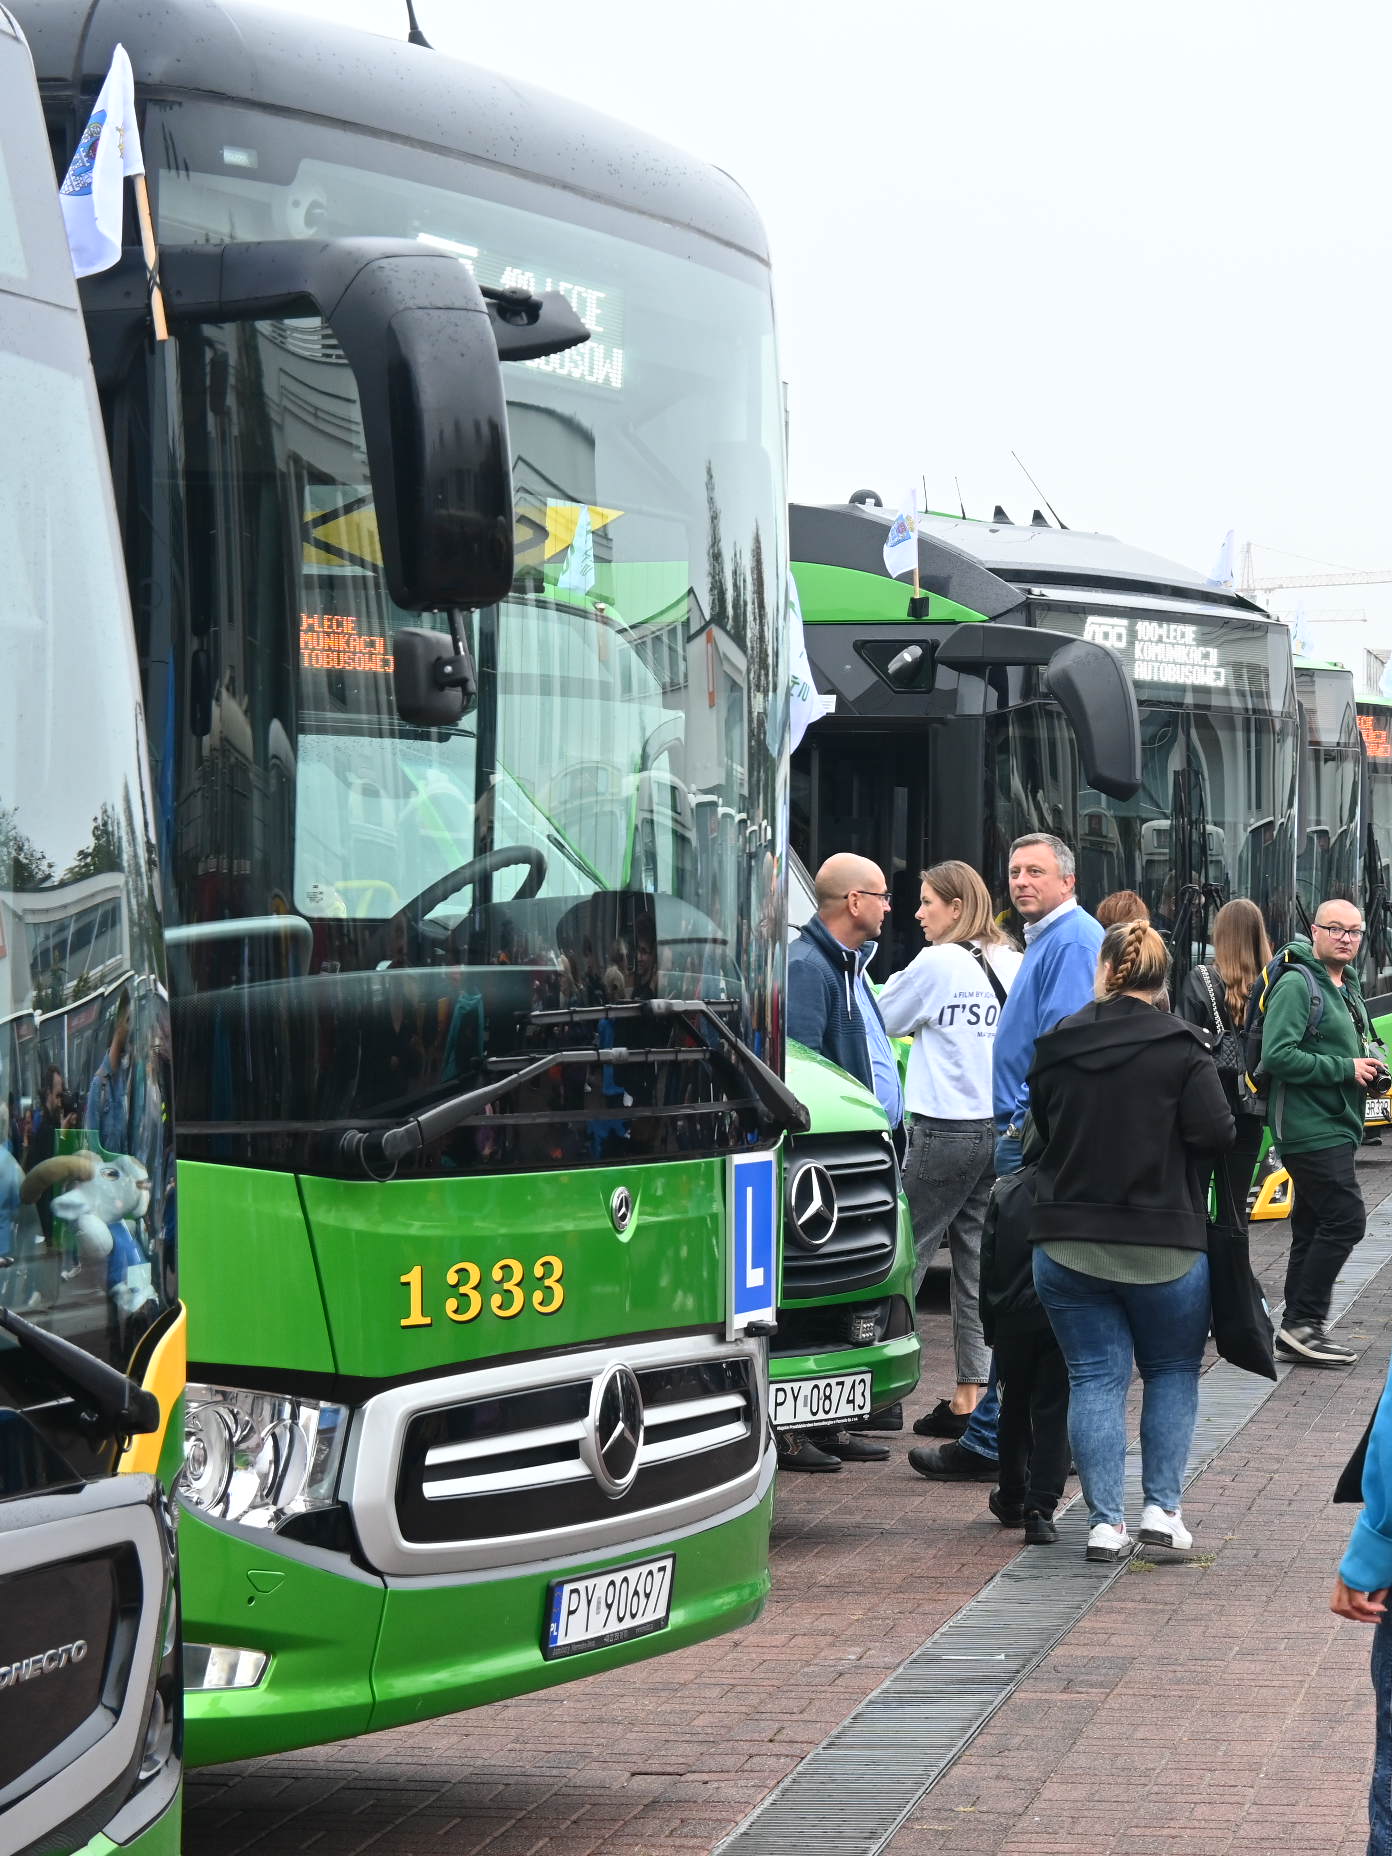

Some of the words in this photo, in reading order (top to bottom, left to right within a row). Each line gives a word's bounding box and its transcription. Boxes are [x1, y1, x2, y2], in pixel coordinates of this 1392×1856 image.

[1136, 619, 1197, 645] 100-LECIE
[1134, 640, 1219, 666] KOMUNIKACJI
[1134, 660, 1226, 687] AUTOBUSOWEJ
[938, 1003, 981, 1026] IT'S
[746, 1186, 764, 1288] L
[399, 1255, 566, 1329] 1333
[773, 1385, 801, 1421] PY
[809, 1378, 867, 1417] 08743
[564, 1582, 598, 1638] PY
[602, 1564, 668, 1629] 90697
